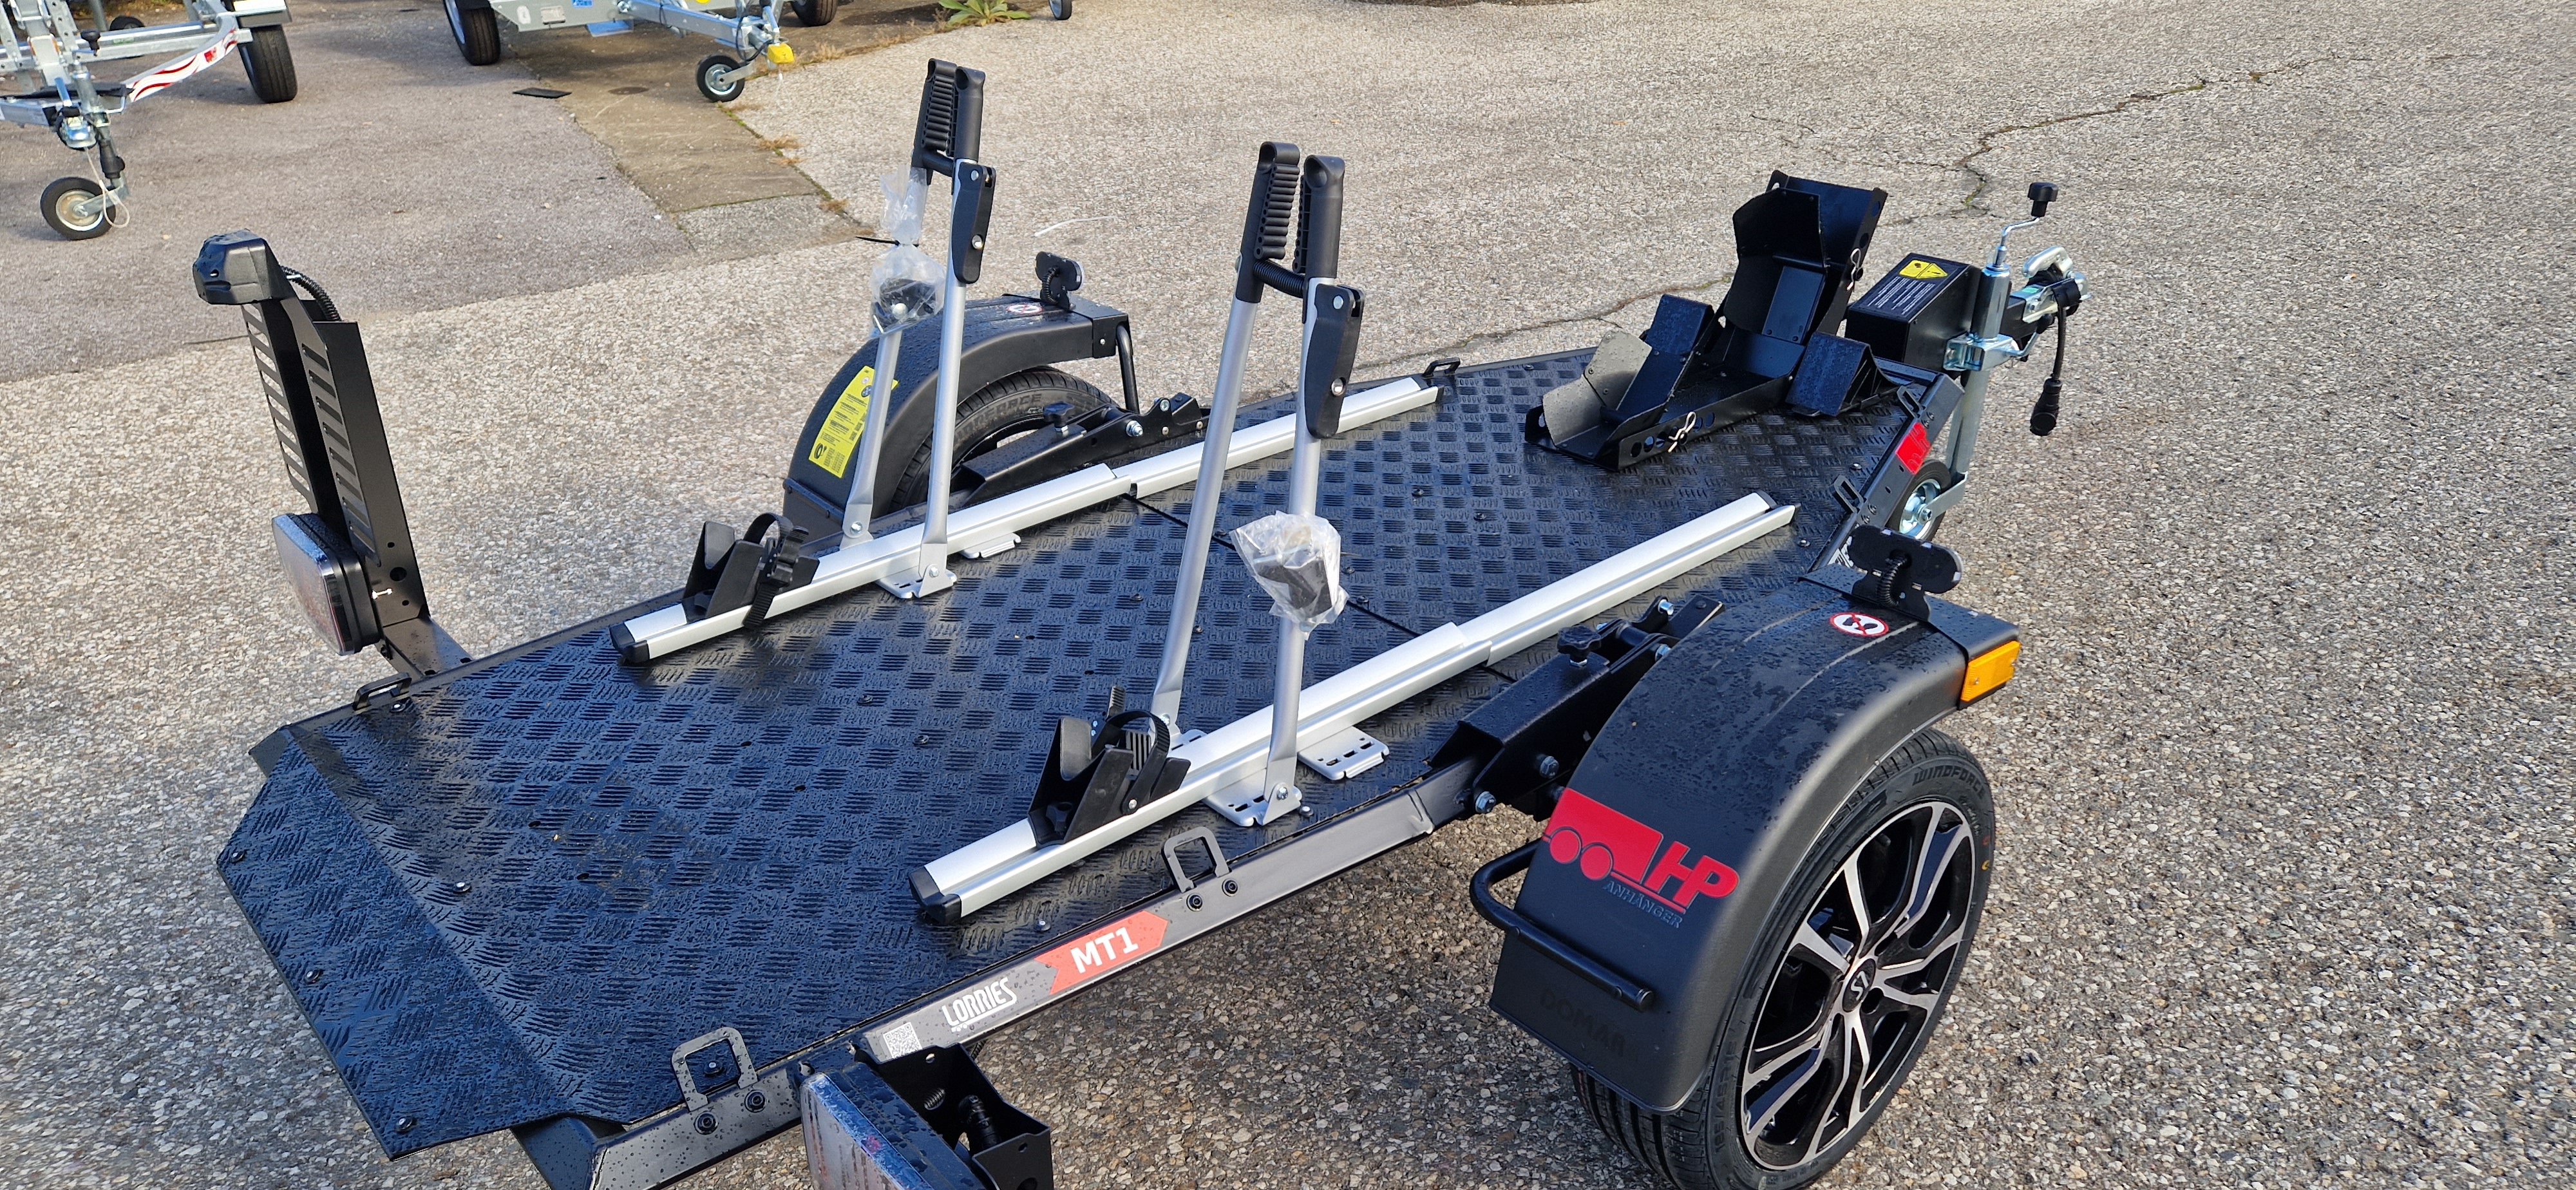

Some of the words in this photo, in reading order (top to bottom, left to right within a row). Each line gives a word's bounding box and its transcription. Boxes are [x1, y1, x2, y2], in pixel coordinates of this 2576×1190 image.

[1912, 764, 1985, 799] WINDFORCE
[1643, 840, 1740, 909] HP
[1070, 927, 1139, 974] MT1
[941, 977, 1018, 1027] LORRIES
